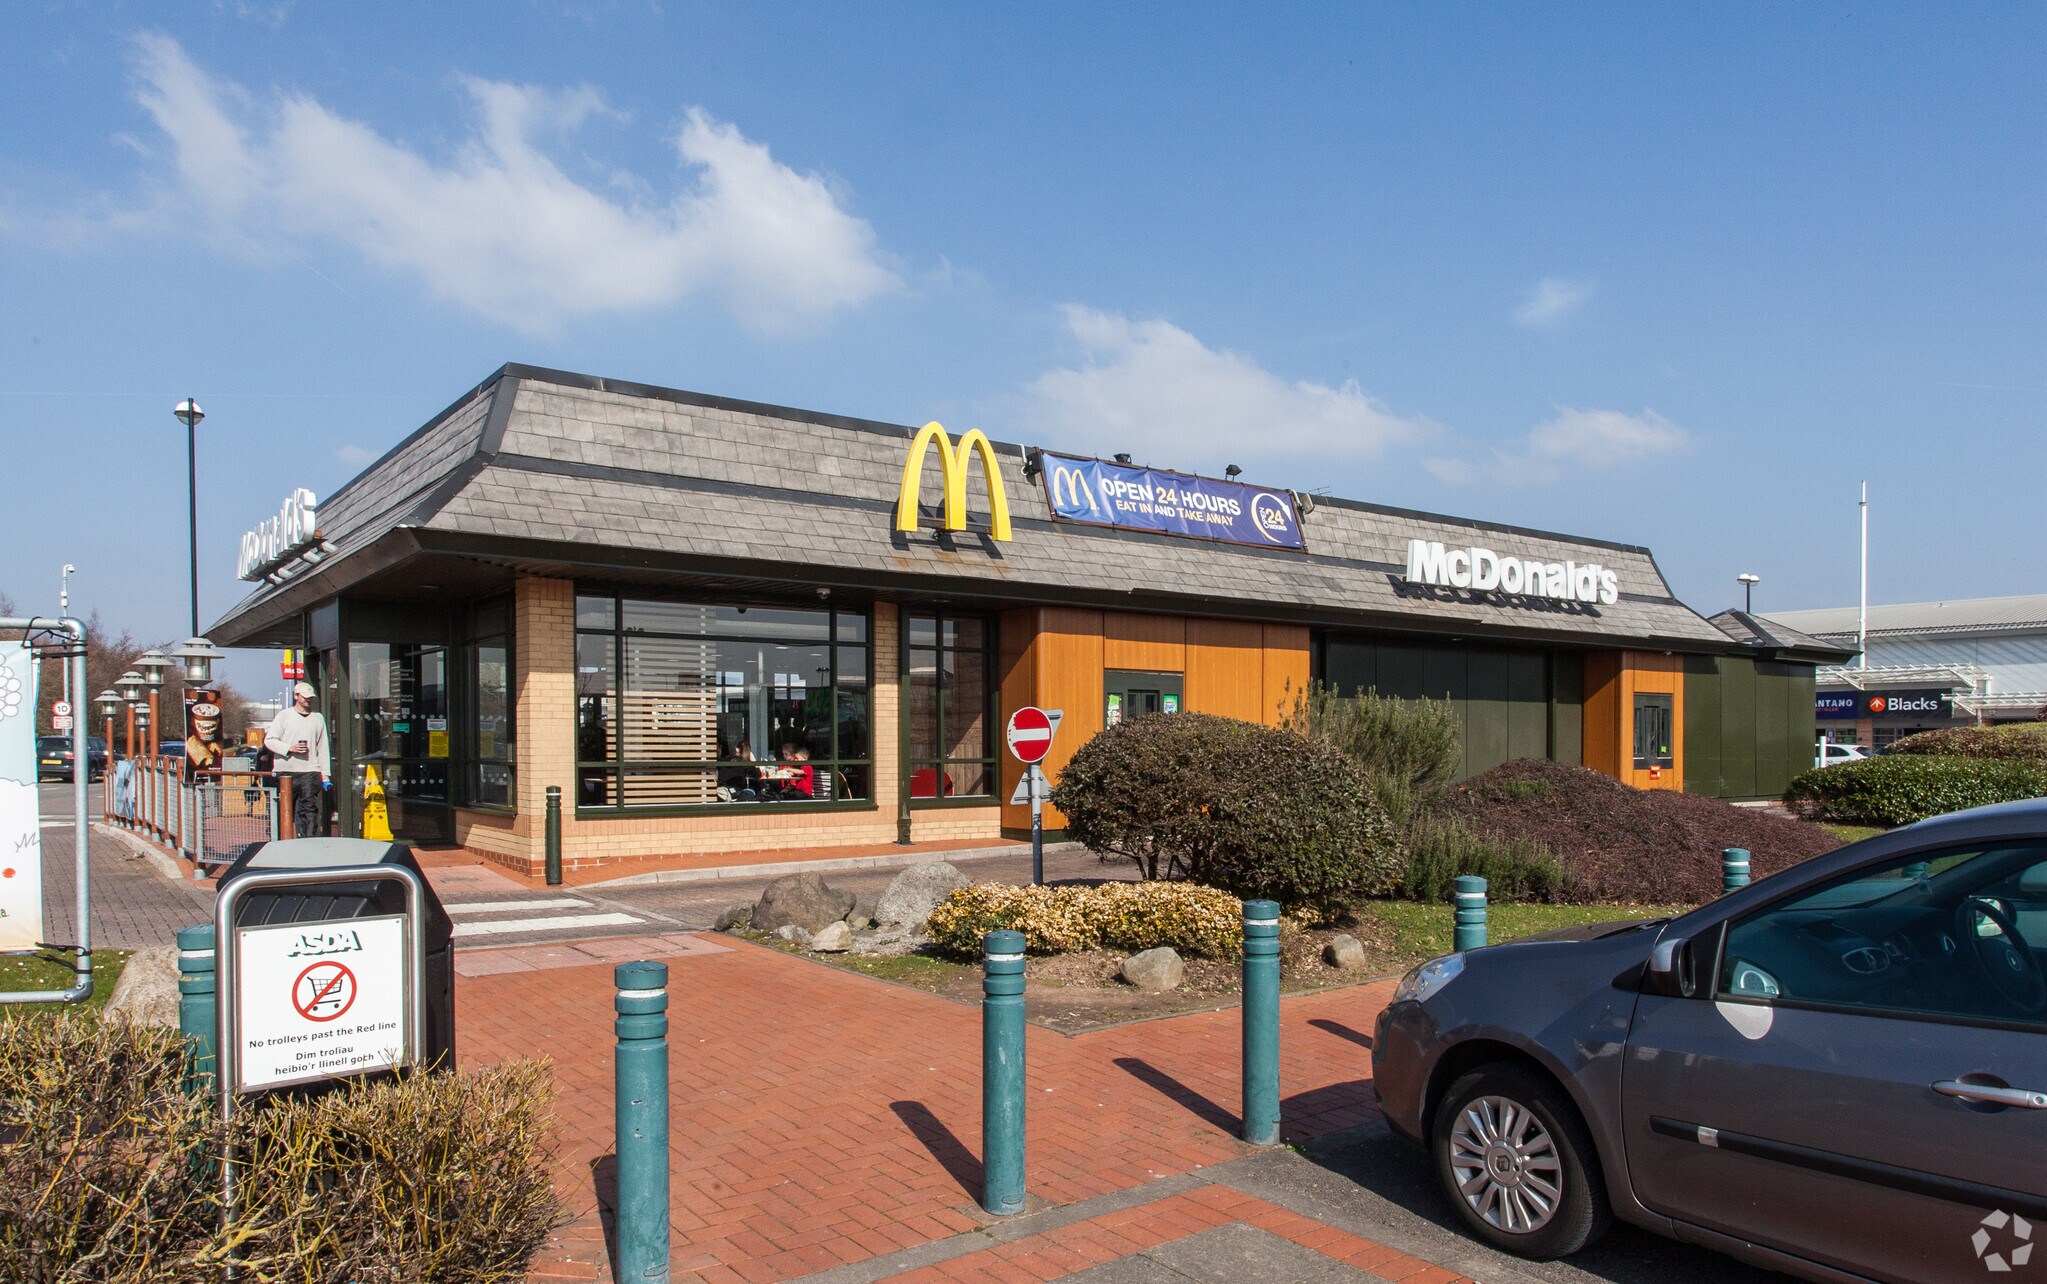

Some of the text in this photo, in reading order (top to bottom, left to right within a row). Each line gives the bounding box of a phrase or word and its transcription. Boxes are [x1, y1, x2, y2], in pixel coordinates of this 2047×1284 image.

[1101, 478, 1241, 515] OPEN 24 HOURS
[1116, 500, 1233, 526] EAT IN AND TAKE AWAY
[1265, 508, 1285, 525] 24
[1406, 539, 1618, 605] McDonald's
[57, 705, 68, 713] 10
[1887, 697, 1938, 711] Blacks
[287, 929, 363, 957] ASDA
[249, 1021, 397, 1049] No trolleys past the Red line
[275, 1053, 375, 1076] heibio'r llinell goch
[296, 1051, 316, 1061] Dim
